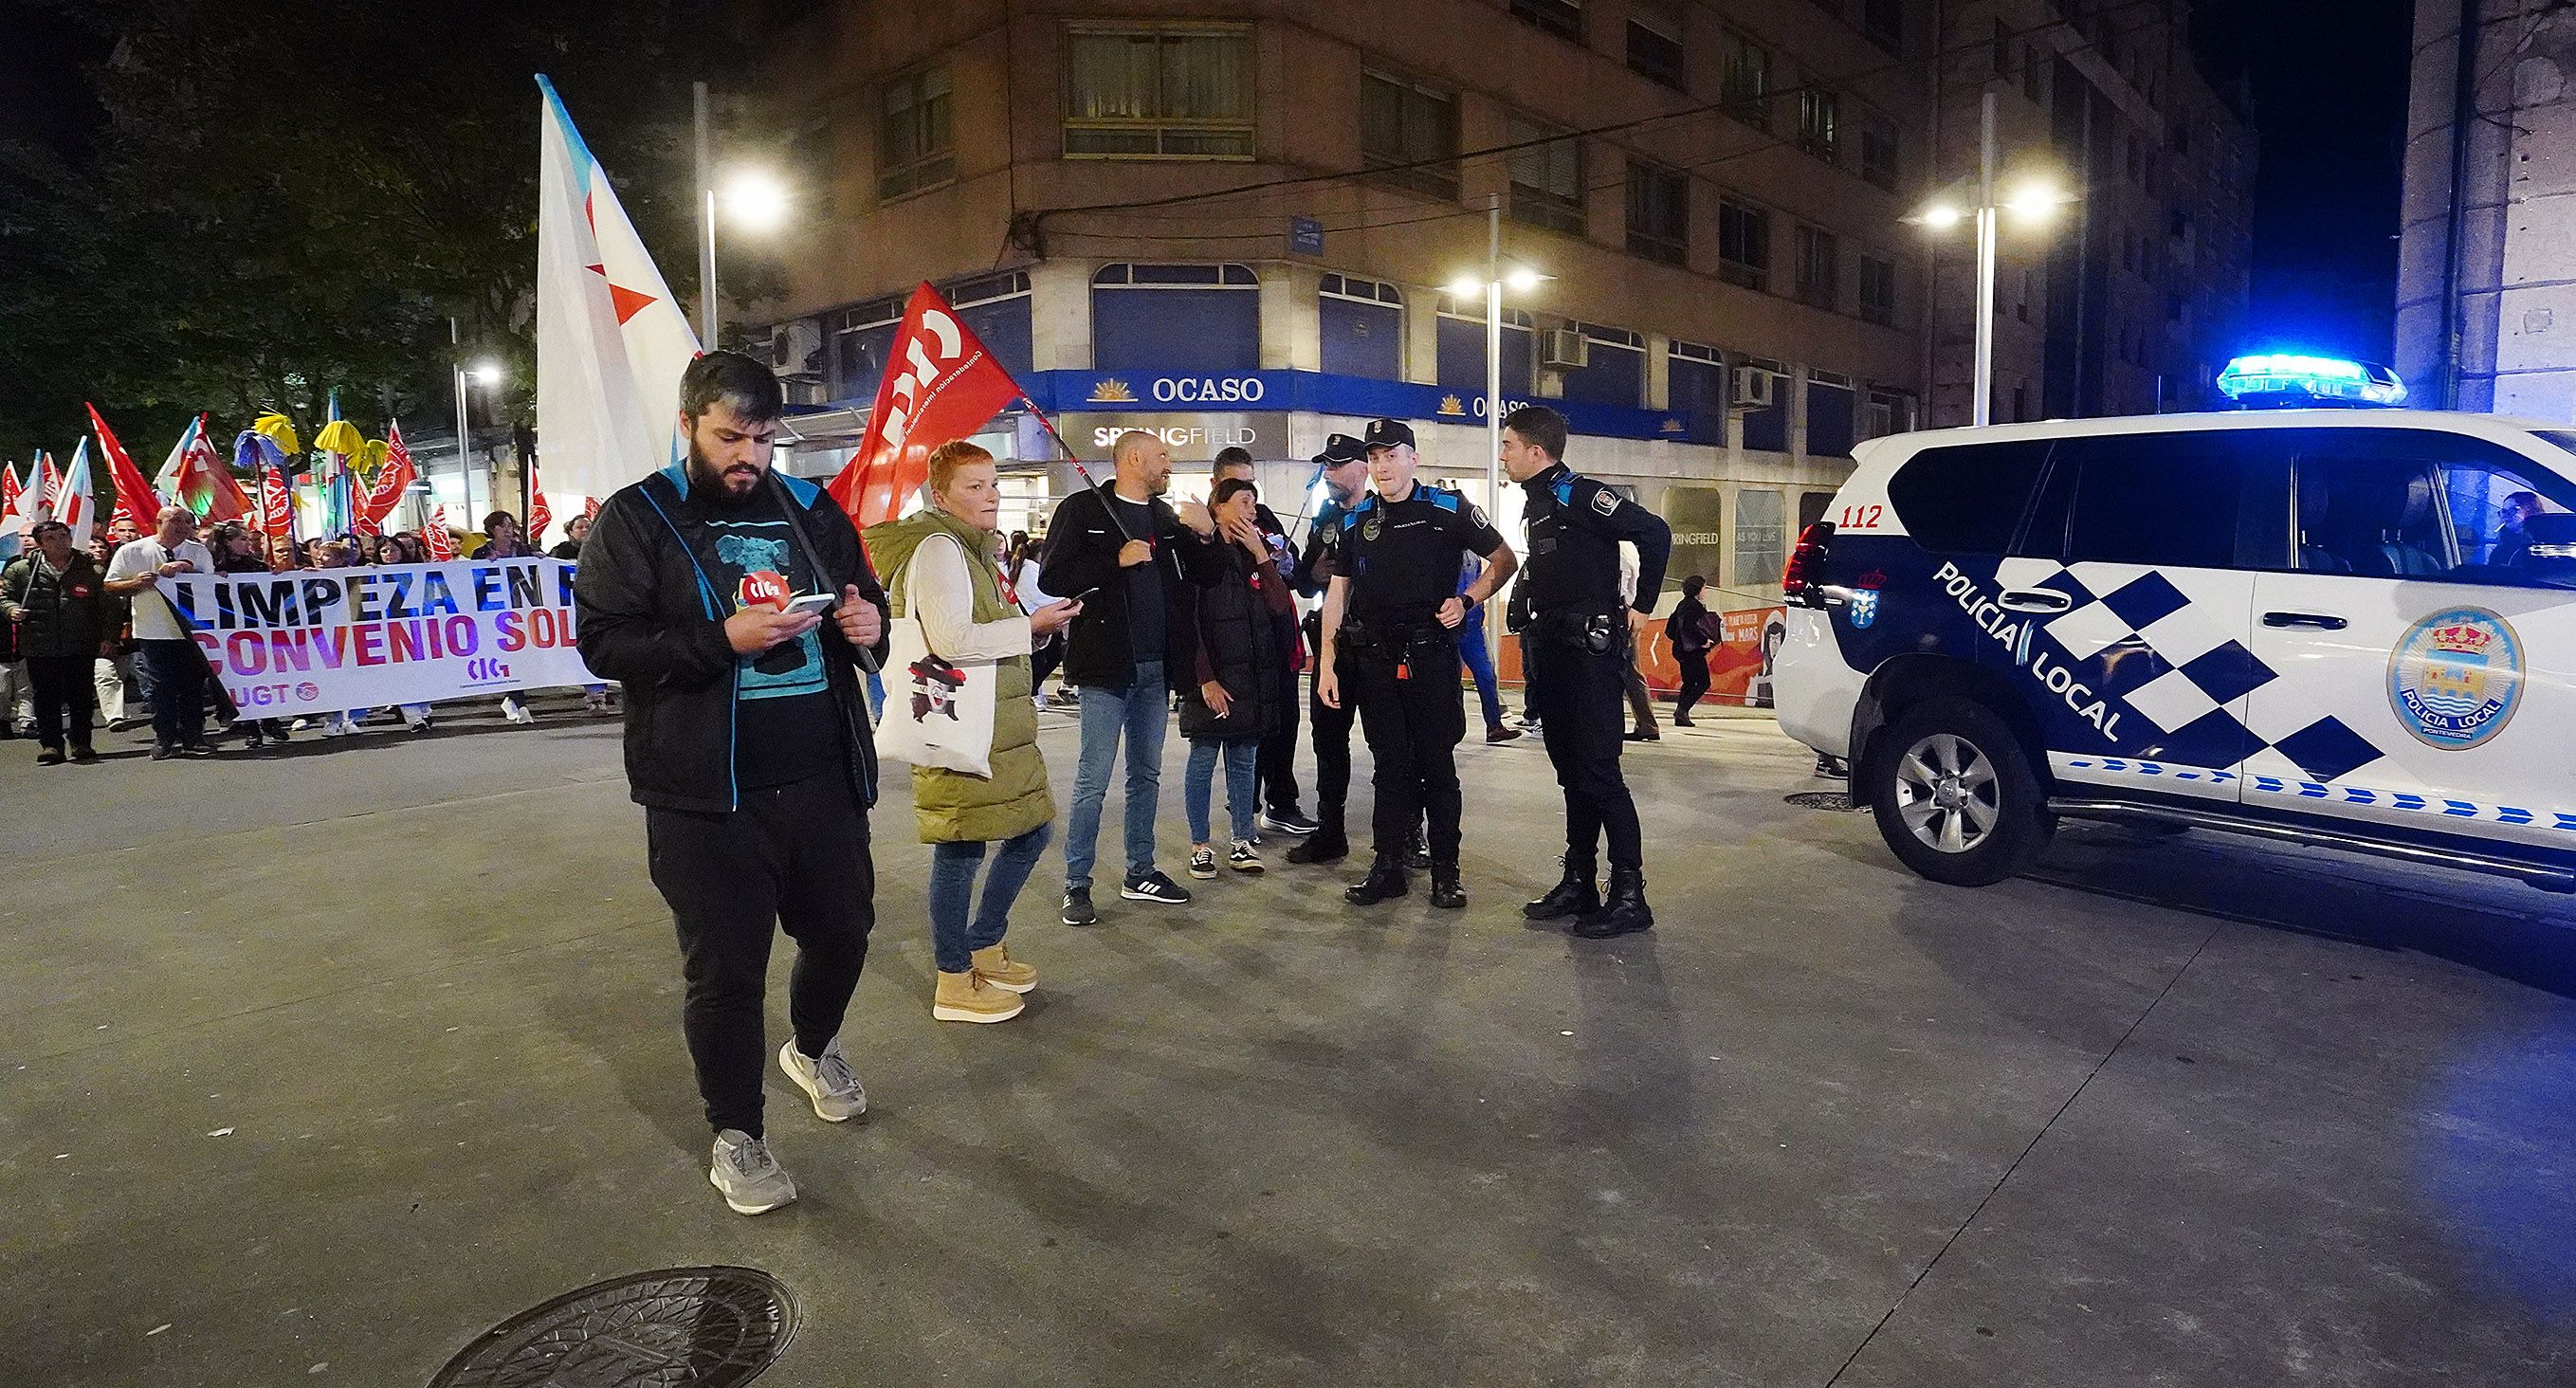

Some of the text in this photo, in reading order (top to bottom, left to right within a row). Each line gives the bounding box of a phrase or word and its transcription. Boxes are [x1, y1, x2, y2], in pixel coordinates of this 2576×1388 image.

[1152, 377, 1265, 402] OCASO
[1472, 396, 1530, 419] OAS
[1093, 427, 1256, 447] SPNGFIELD
[1838, 504, 1882, 528] 112
[175, 571, 459, 630] LIMPEZA
[472, 565, 543, 612] EN
[750, 580, 780, 598] CIG
[192, 614, 479, 676] CONVENIO
[1932, 560, 2121, 742] POLICIA LOCAL
[467, 658, 510, 680] CIG
[229, 684, 289, 708] UGT
[2402, 690, 2501, 728] POLICIA LOCAL
[2422, 728, 2473, 740] PONTEVEDRA
